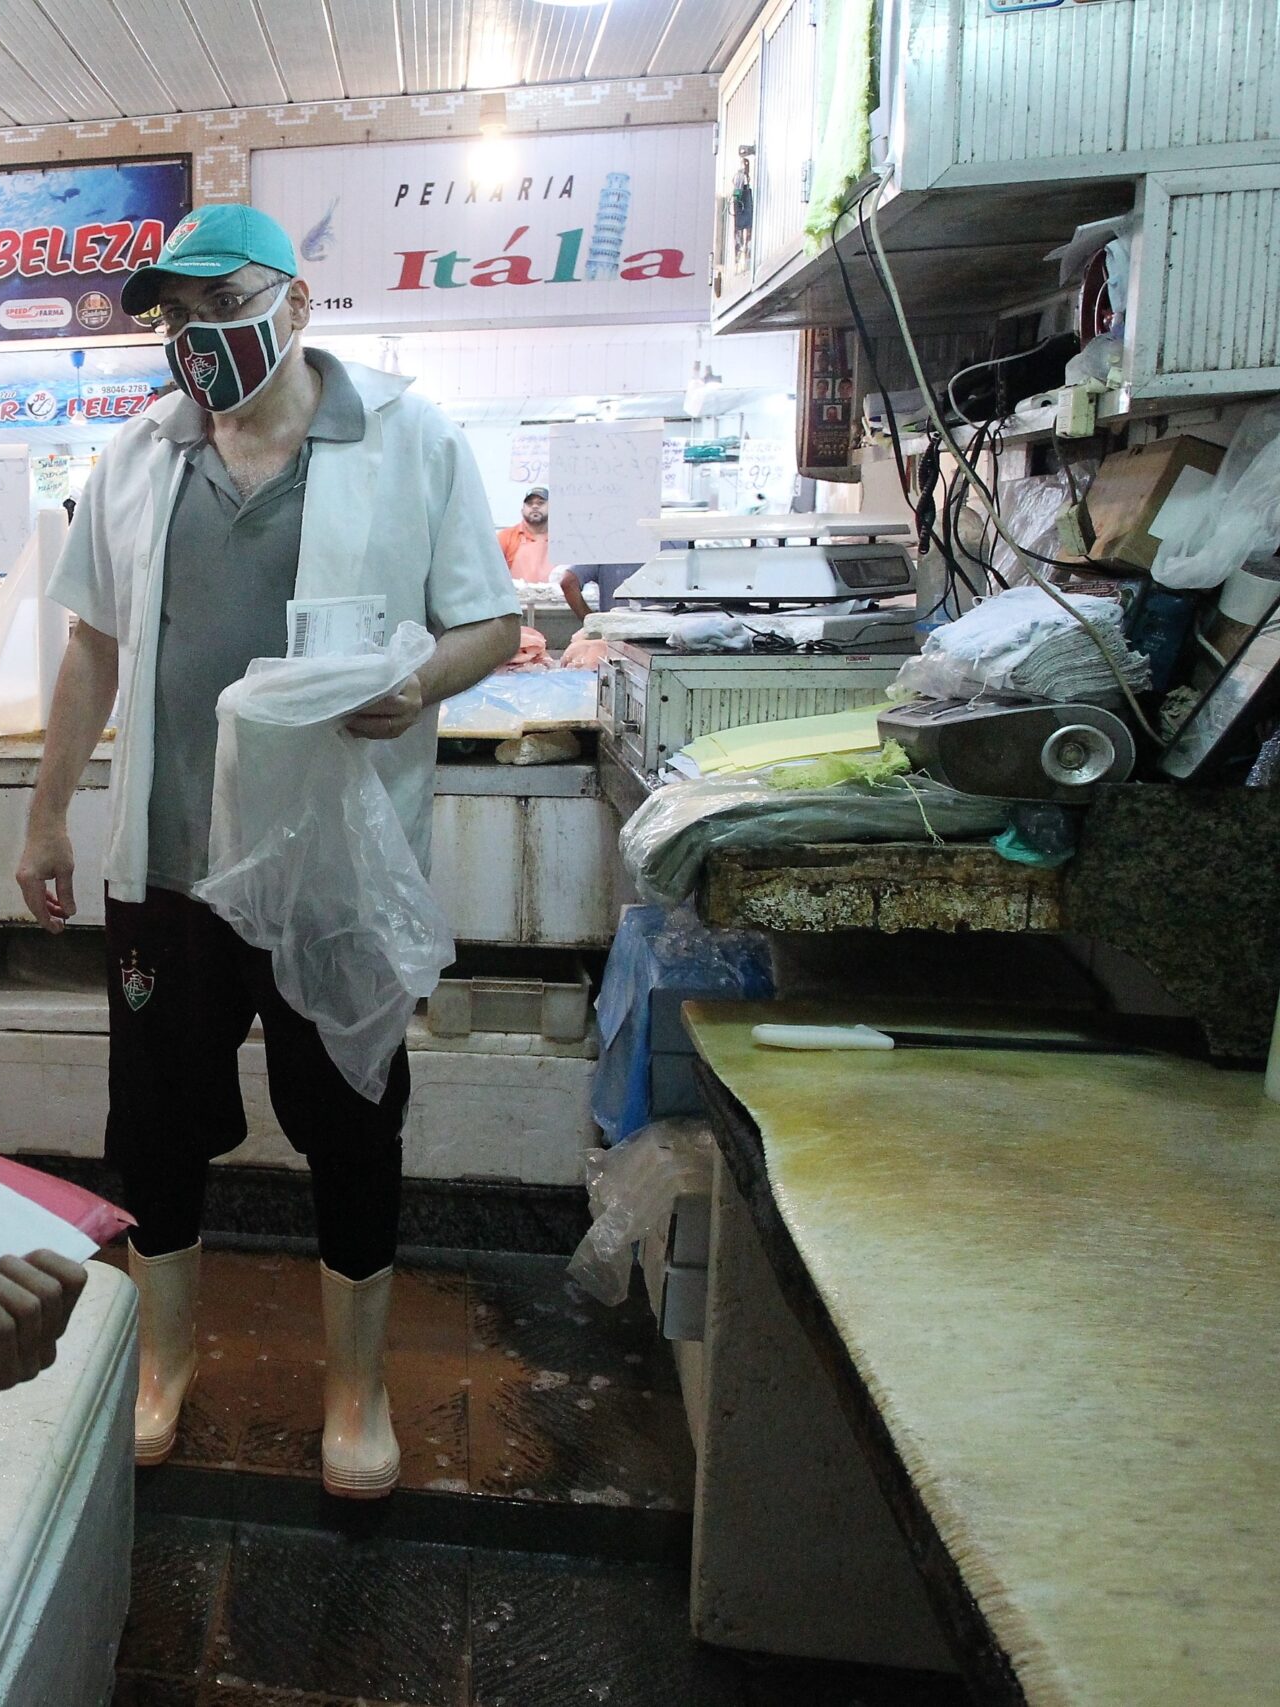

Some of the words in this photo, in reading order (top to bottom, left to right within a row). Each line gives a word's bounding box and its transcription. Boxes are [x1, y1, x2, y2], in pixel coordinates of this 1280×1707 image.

[394, 174, 575, 207] PEIXARIA
[386, 225, 696, 290] Itála
[5, 307, 29, 316] SPEED
[38, 309, 65, 317] FARMA
[101, 384, 149, 394] 98046-2783
